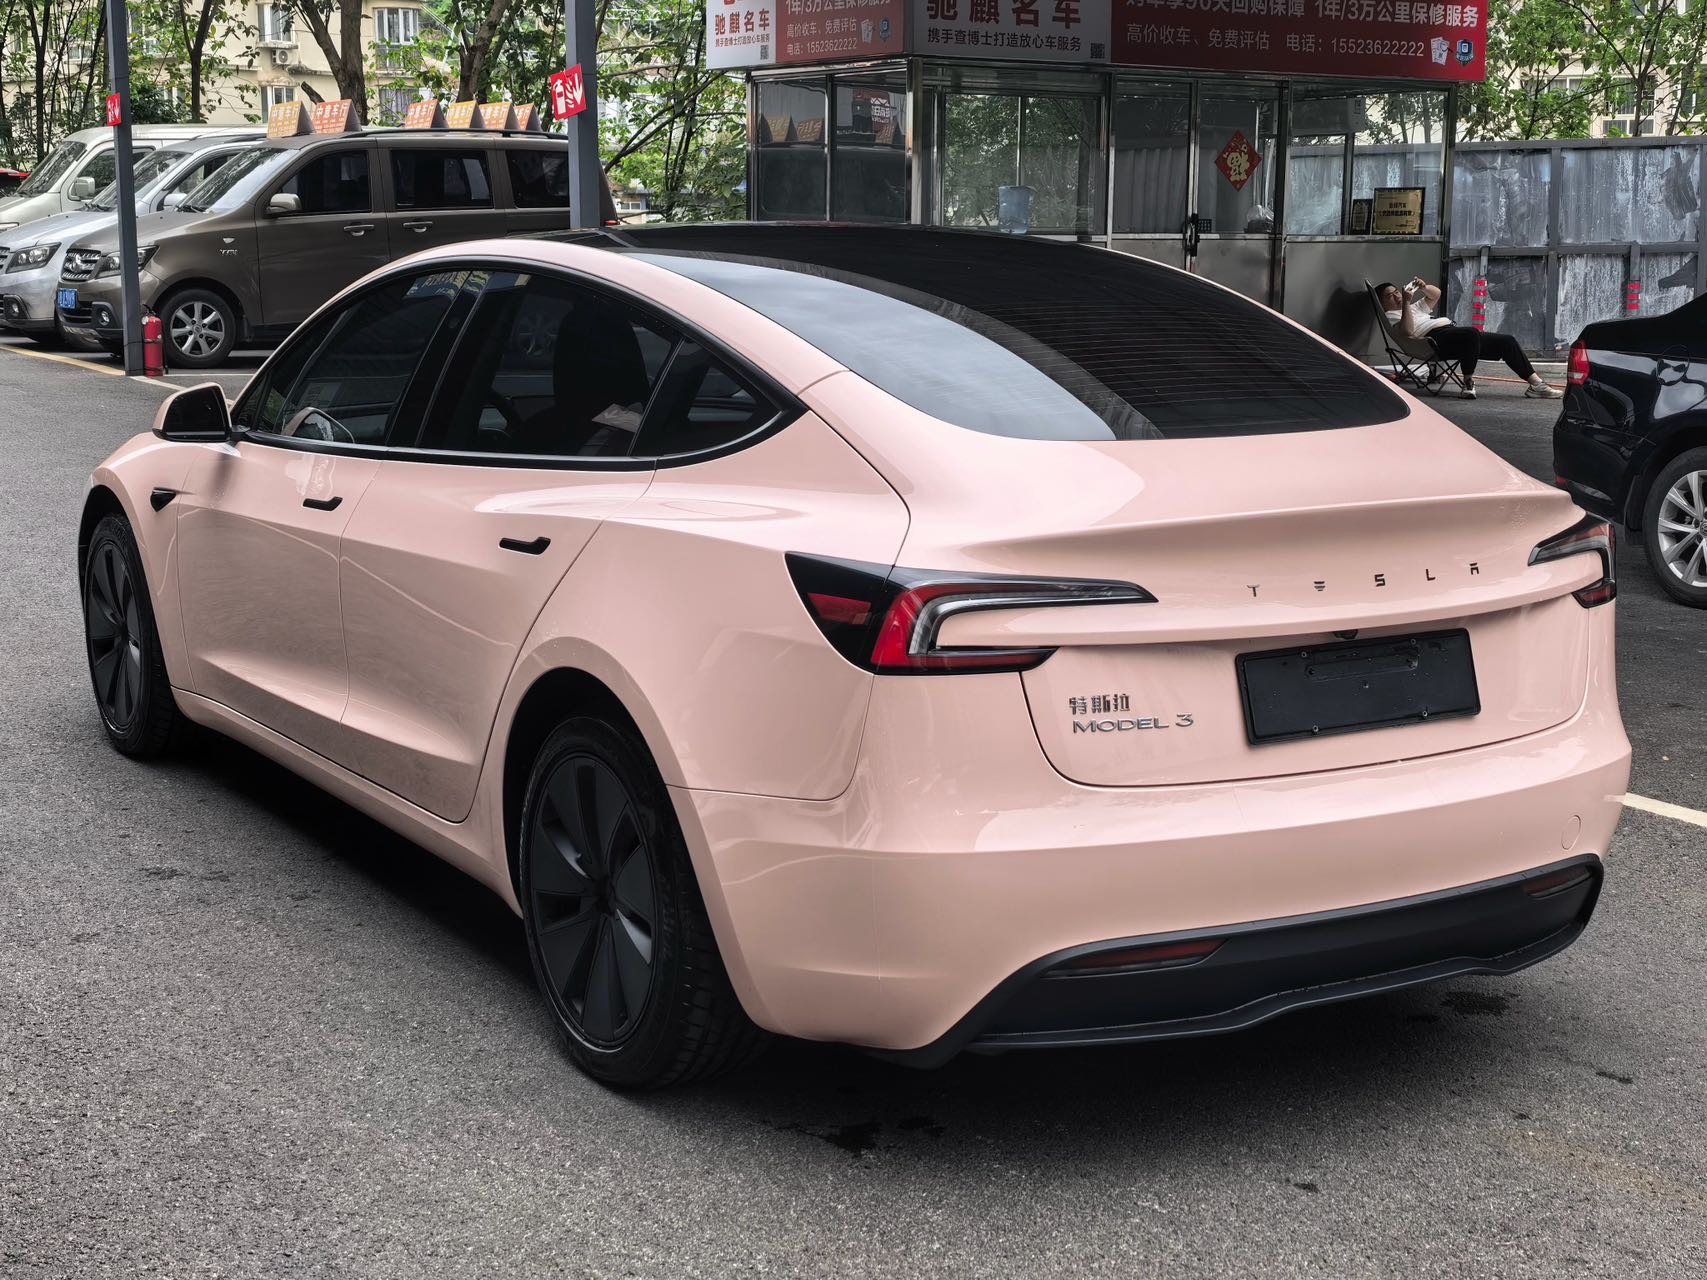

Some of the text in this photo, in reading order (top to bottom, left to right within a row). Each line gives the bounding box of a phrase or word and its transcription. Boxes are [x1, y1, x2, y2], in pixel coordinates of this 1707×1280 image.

[927, 26, 1081, 52] 携手查博士打造放心车服务
[1246, 562, 1480, 597] TESLA
[1068, 693, 1131, 715] 特斯拉
[1073, 712, 1194, 734] MODEL 3
